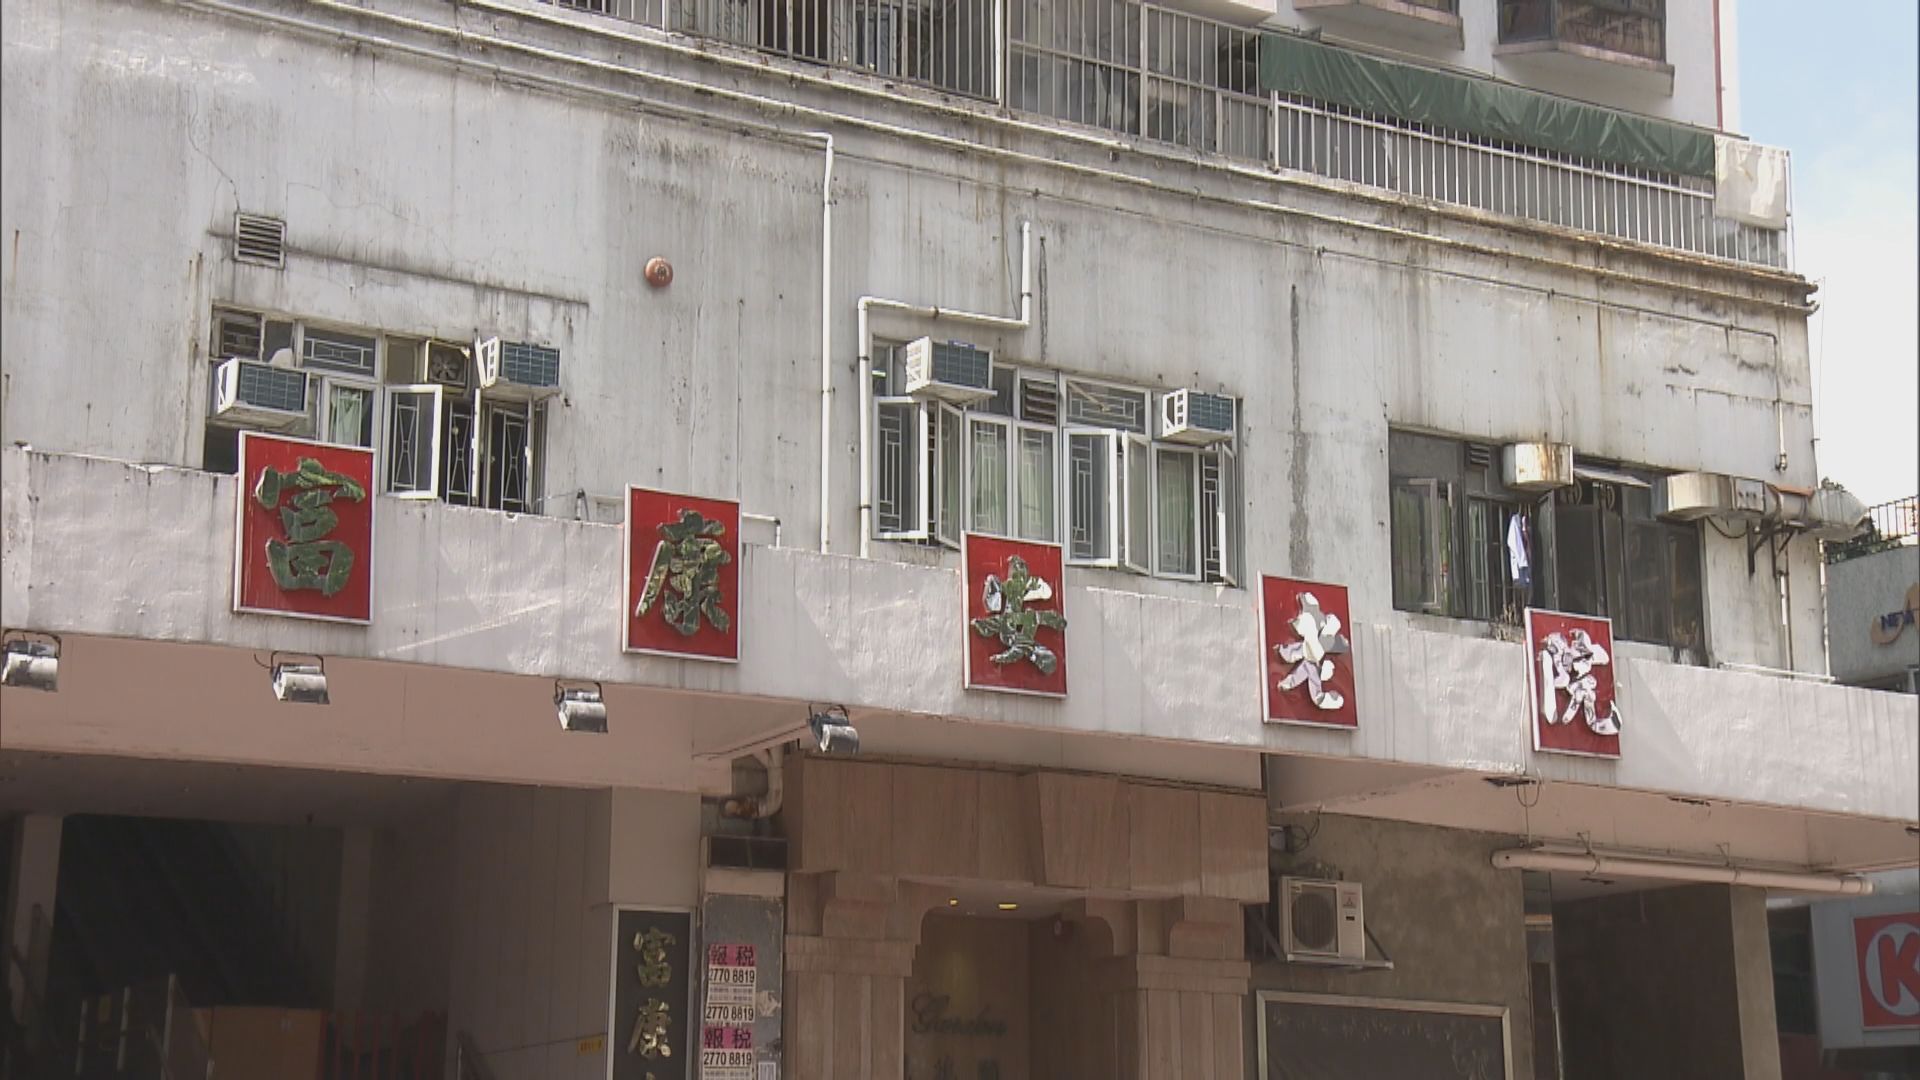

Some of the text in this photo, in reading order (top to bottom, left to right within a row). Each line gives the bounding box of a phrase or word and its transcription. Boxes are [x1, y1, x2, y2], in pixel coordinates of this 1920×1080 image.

[709, 968, 755, 983] 2770 8819
[628, 927, 676, 1080] 富康
[706, 1006, 754, 1021] 2770 8819
[704, 1052, 752, 1066] 2770 8819
